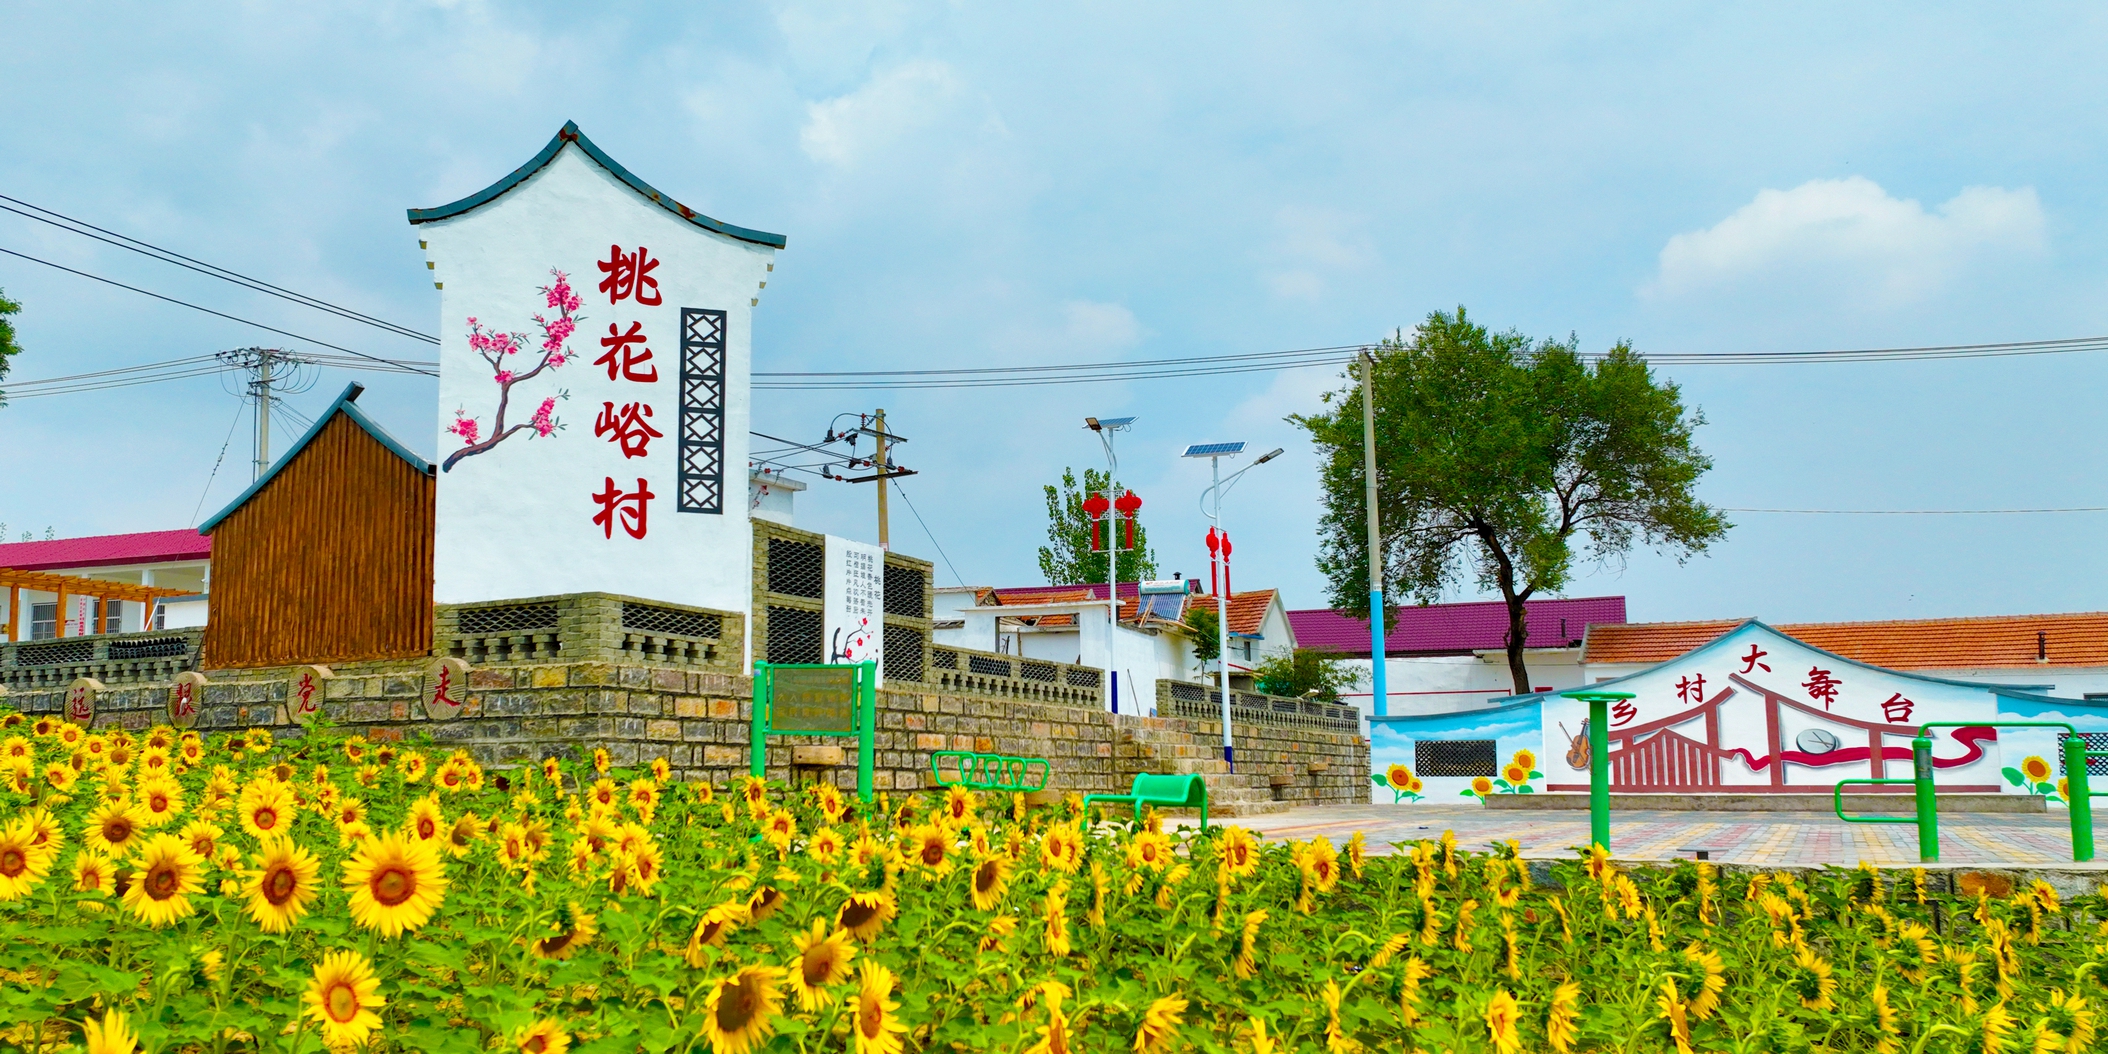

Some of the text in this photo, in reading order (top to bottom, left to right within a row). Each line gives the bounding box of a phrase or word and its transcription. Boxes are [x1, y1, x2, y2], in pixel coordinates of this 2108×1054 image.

[592, 244, 664, 540] 桃花峪村
[873, 575, 882, 601] 桃花
[296, 673, 318, 714] 党
[432, 664, 462, 708] 走
[1610, 643, 1915, 727] 乡村大舞台
